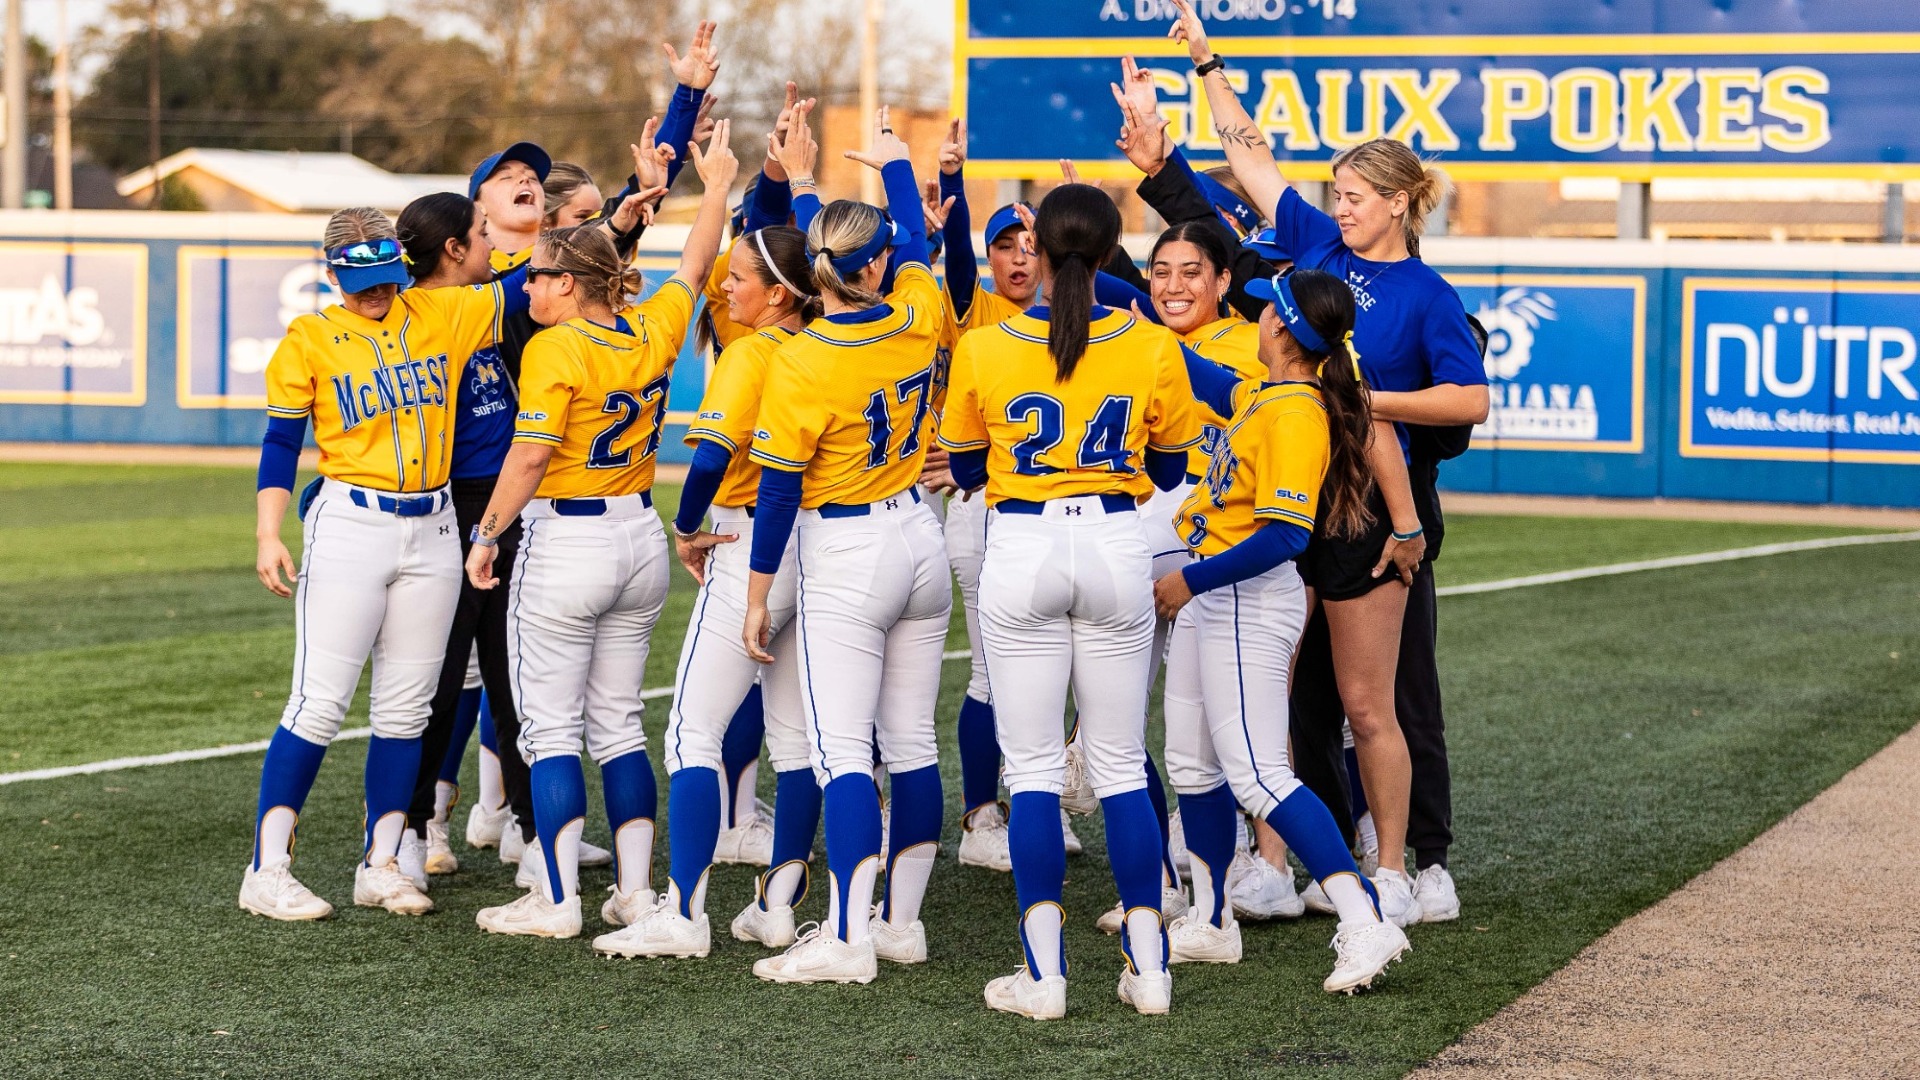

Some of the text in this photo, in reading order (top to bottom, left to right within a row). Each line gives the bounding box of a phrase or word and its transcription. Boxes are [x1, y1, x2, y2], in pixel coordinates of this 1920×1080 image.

[1478, 66, 1832, 153] POKES
[518, 411, 547, 421] SLC
[862, 357, 935, 471] 17
[1004, 391, 1139, 476] 24
[1276, 489, 1308, 503] SLC
